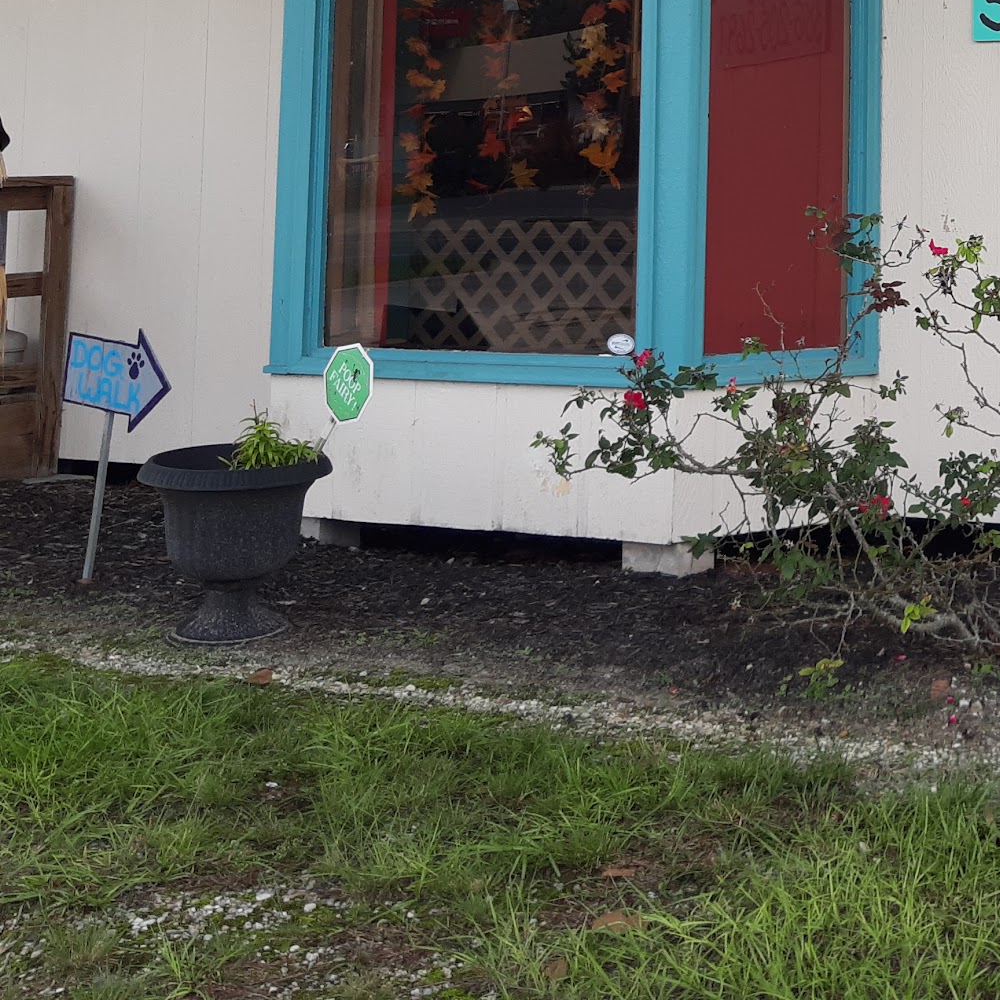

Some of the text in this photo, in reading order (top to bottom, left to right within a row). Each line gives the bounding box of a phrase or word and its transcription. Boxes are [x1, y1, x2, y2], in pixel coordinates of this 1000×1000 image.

[70, 338, 124, 377] DOG
[77, 372, 142, 414] WALK
[338, 361, 362, 394] POOP
